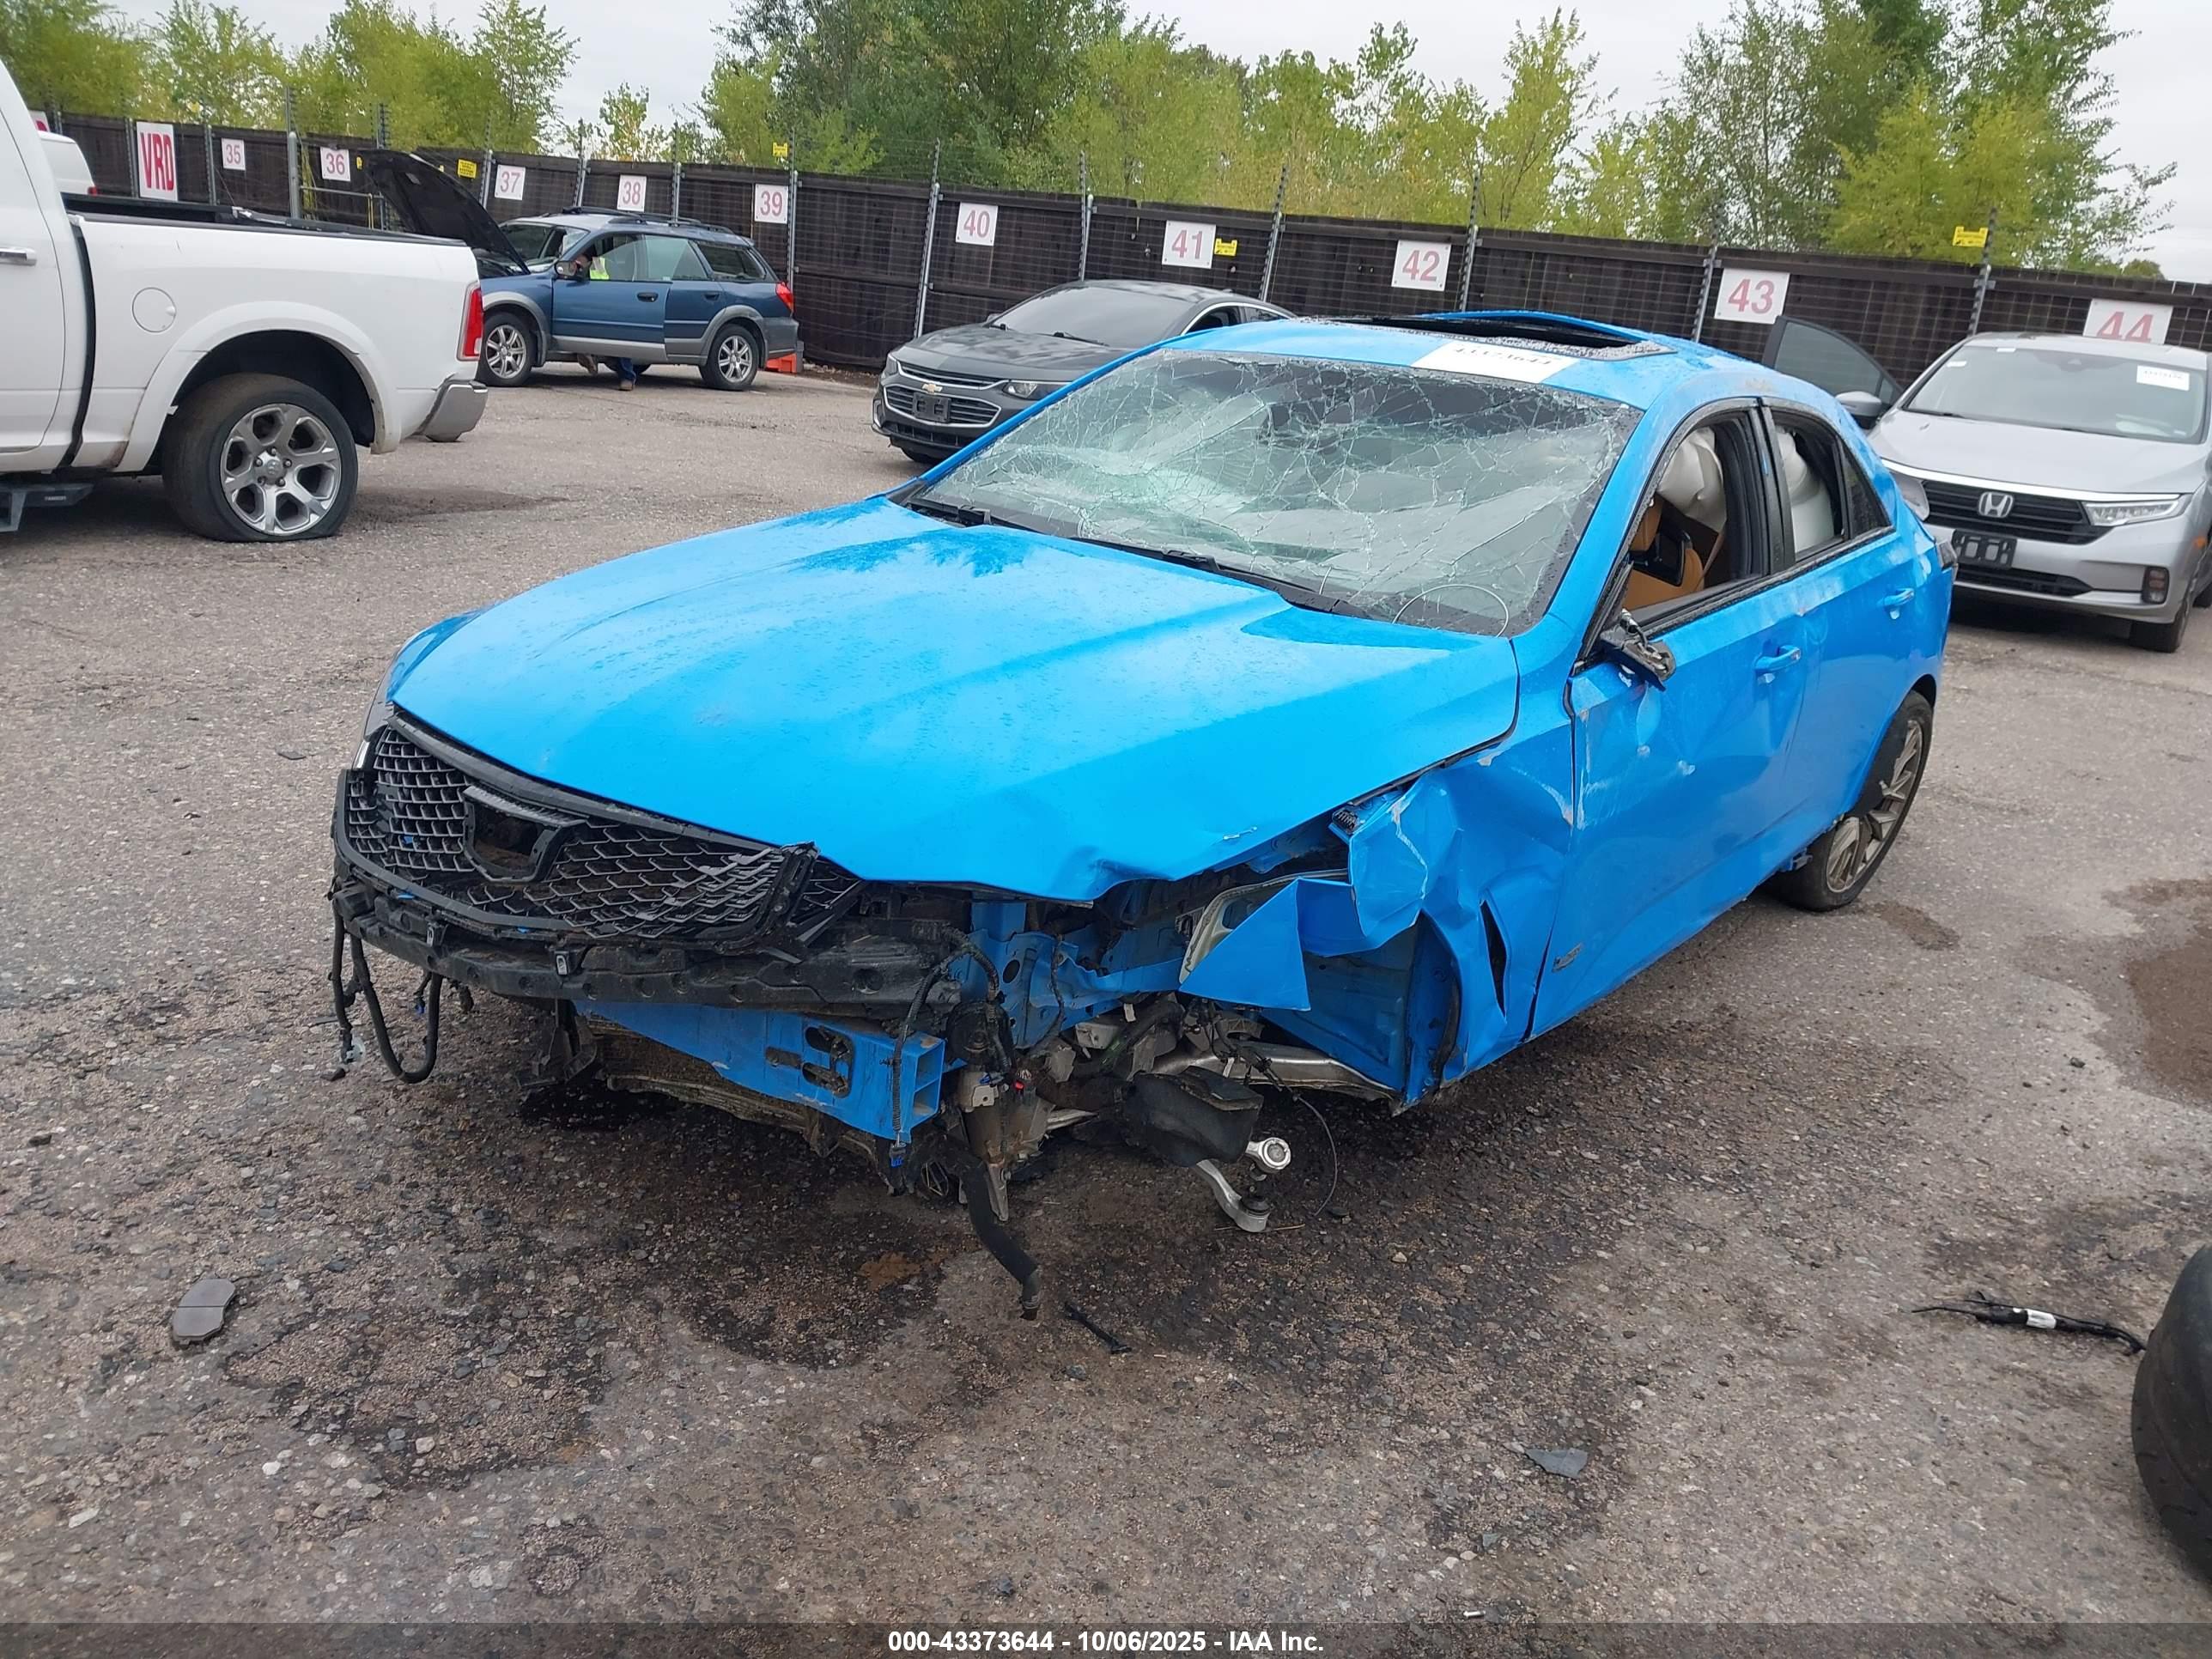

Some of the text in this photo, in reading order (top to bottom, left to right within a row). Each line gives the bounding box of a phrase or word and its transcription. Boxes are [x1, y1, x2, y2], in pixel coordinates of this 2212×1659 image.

[140, 132, 175, 191] VRD
[226, 143, 241, 165] 35
[325, 153, 344, 175] 36
[500, 171, 520, 193] 37
[623, 181, 641, 205] 38
[760, 191, 783, 216] 39
[963, 210, 990, 238] 40
[1171, 229, 1204, 260] 41
[1402, 250, 1441, 283] 42
[1728, 277, 1775, 314] 43
[2096, 312, 2154, 343] 44
